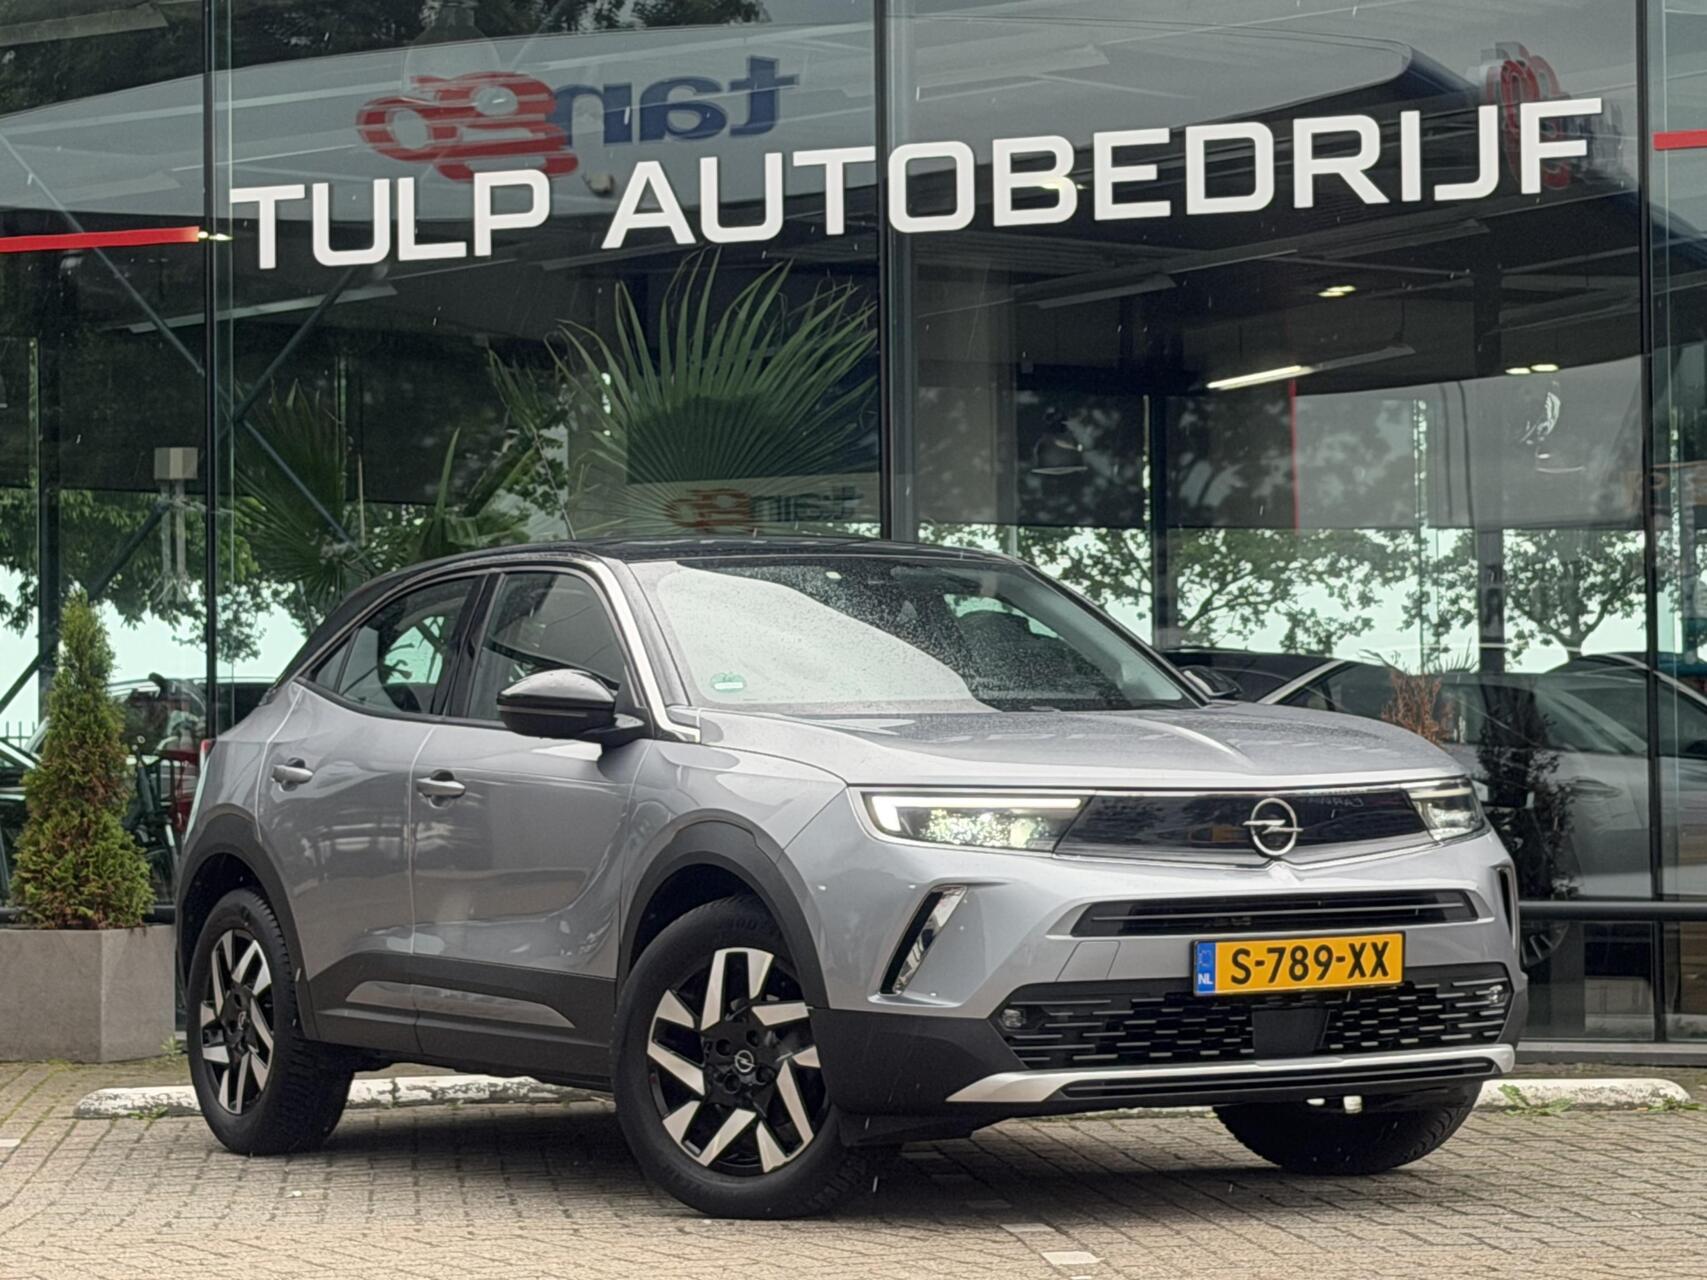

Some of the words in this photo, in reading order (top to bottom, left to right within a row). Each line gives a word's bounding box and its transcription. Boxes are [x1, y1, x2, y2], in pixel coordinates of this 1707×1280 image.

[229, 169, 550, 270] TULP
[602, 97, 1603, 250] AUTOBEDRIJF
[1198, 973, 1213, 985] NL
[1230, 941, 1390, 985] S-789-XX
